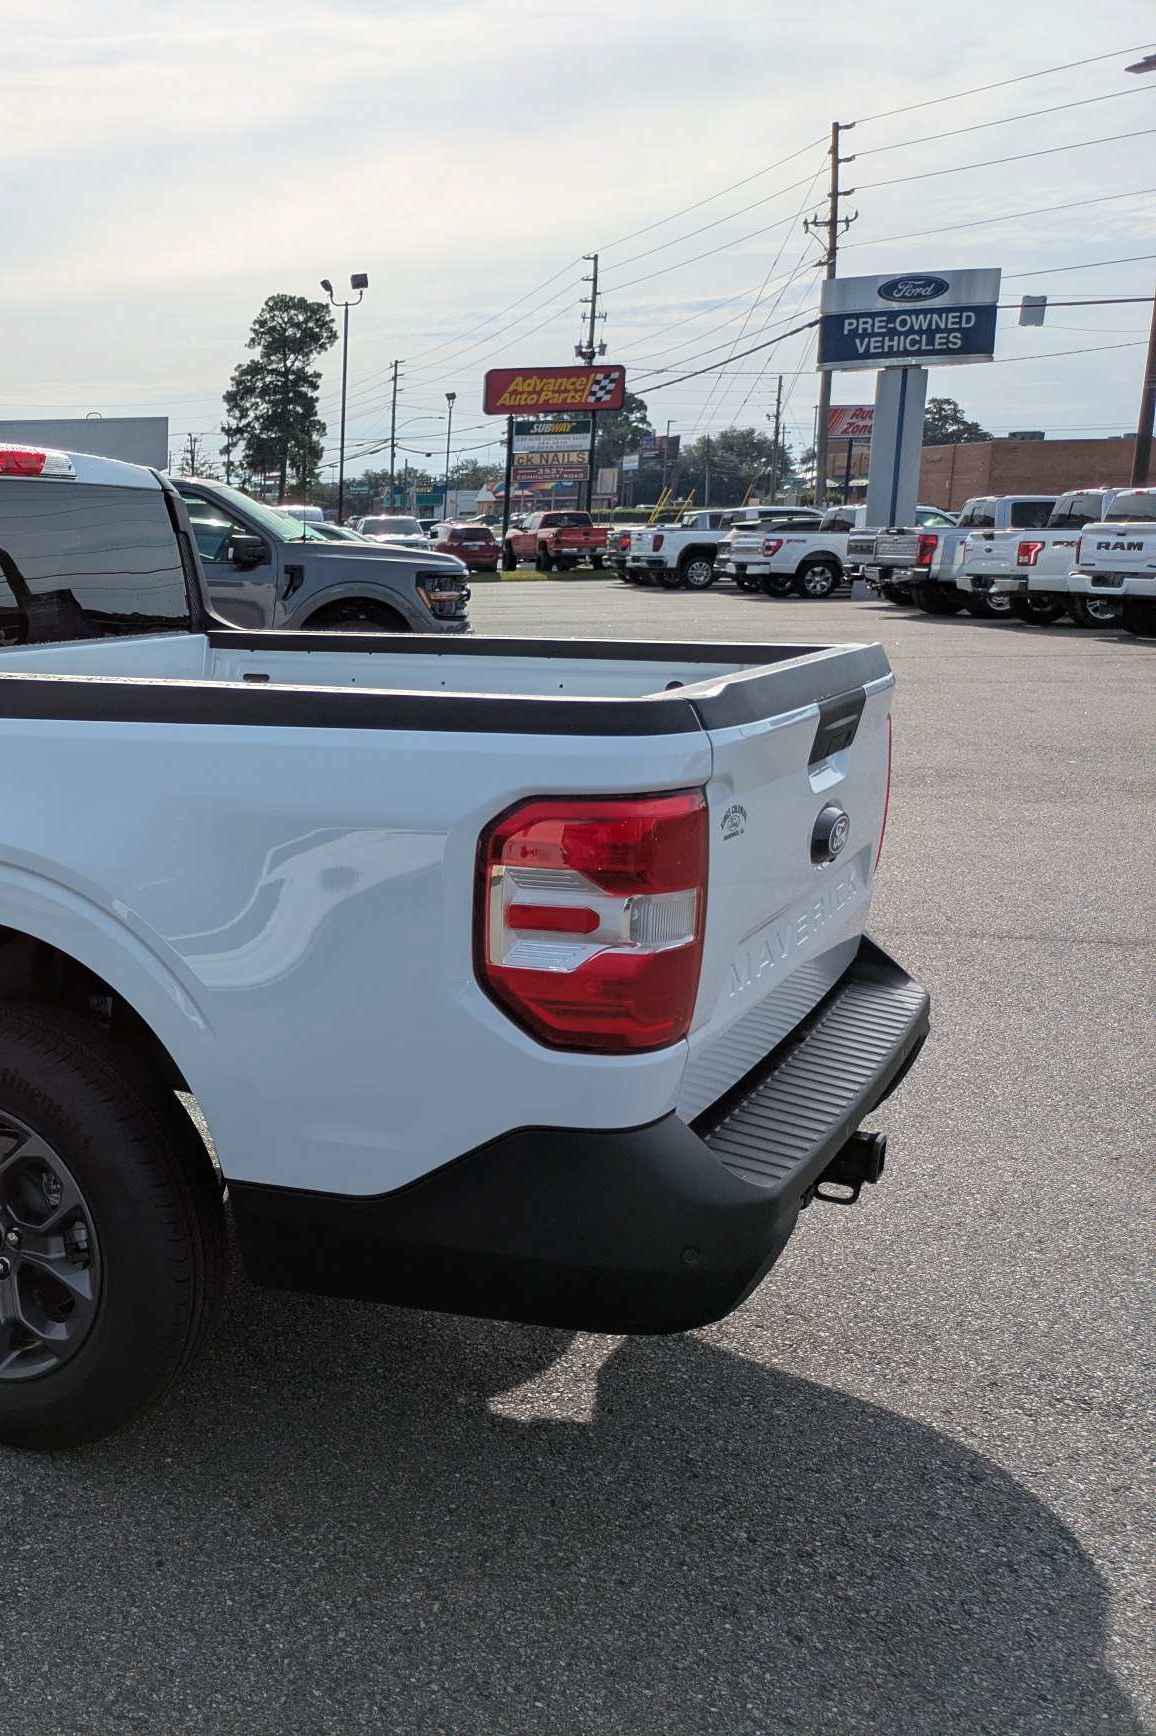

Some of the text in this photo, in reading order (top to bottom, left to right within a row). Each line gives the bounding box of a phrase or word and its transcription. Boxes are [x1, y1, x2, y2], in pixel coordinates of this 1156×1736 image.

[893, 279, 935, 298] Ford
[844, 311, 976, 335] PRE-OWNED
[855, 332, 962, 354] VEHICLES
[507, 376, 587, 392] Advance
[496, 389, 584, 406] Auto Parts
[530, 422, 573, 434] SUBWAY
[539, 452, 586, 465] NAILS
[1096, 541, 1144, 551] RAM
[728, 870, 861, 998] MAVERICK
